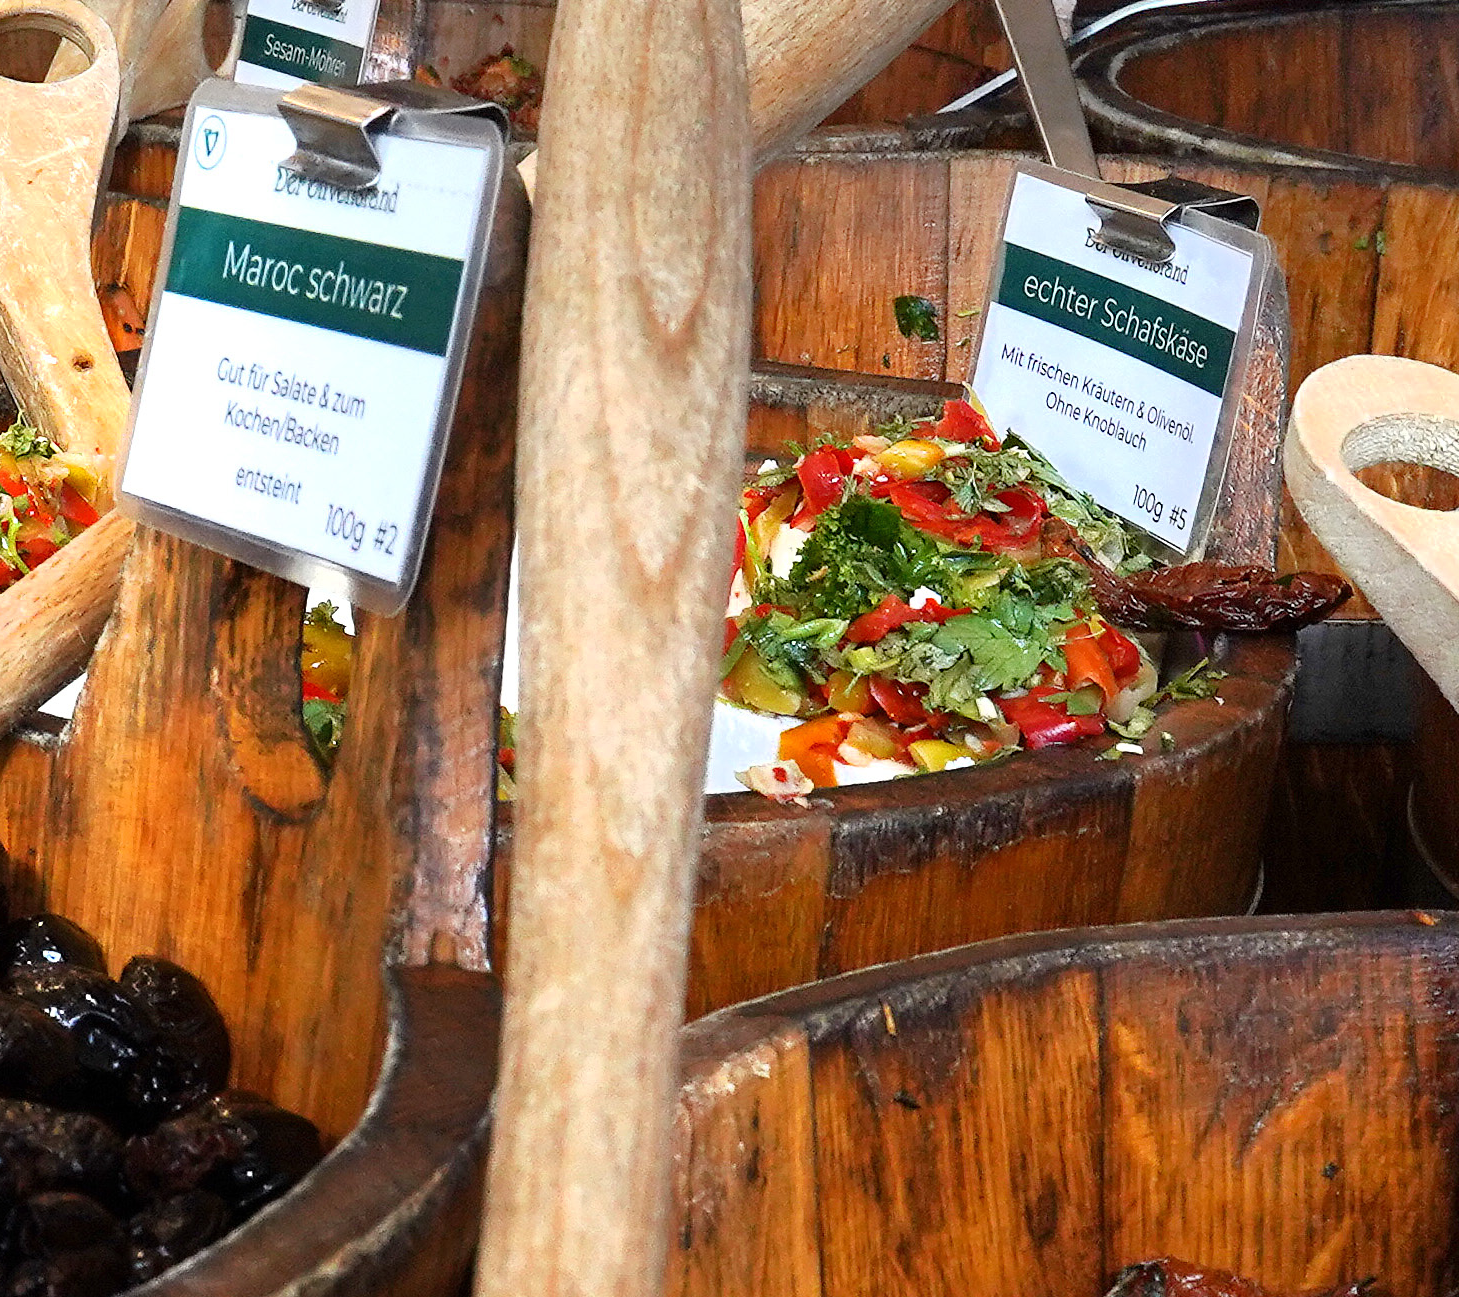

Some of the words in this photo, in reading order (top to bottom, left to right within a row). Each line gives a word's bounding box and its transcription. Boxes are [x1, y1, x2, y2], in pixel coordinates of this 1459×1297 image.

[263, 32, 347, 79] Sesam-Möhren
[222, 240, 305, 296] Maroc
[305, 261, 410, 320] schwarz
[1023, 275, 1099, 321] echter
[1100, 297, 1209, 370] Schafskäse
[217, 357, 246, 387] Gut
[246, 364, 271, 391] für
[270, 371, 318, 407] Salate
[318, 384, 330, 408] &
[331, 391, 367, 420] zum
[1001, 344, 1023, 367] Mit
[1027, 353, 1080, 392] frischen
[1082, 376, 1135, 416] Kräutern
[1136, 400, 1146, 419] &
[1147, 406, 1195, 444] Olivenöl.
[223, 400, 341, 456] Kochen/Backen
[1045, 391, 1081, 421] Ohne
[1083, 407, 1148, 453] Knoblauch
[235, 465, 303, 505] entsteint
[1133, 484, 1164, 523] 100g
[1169, 505, 1189, 531] #5
[324, 504, 367, 552] 100g
[372, 520, 399, 556] #2
